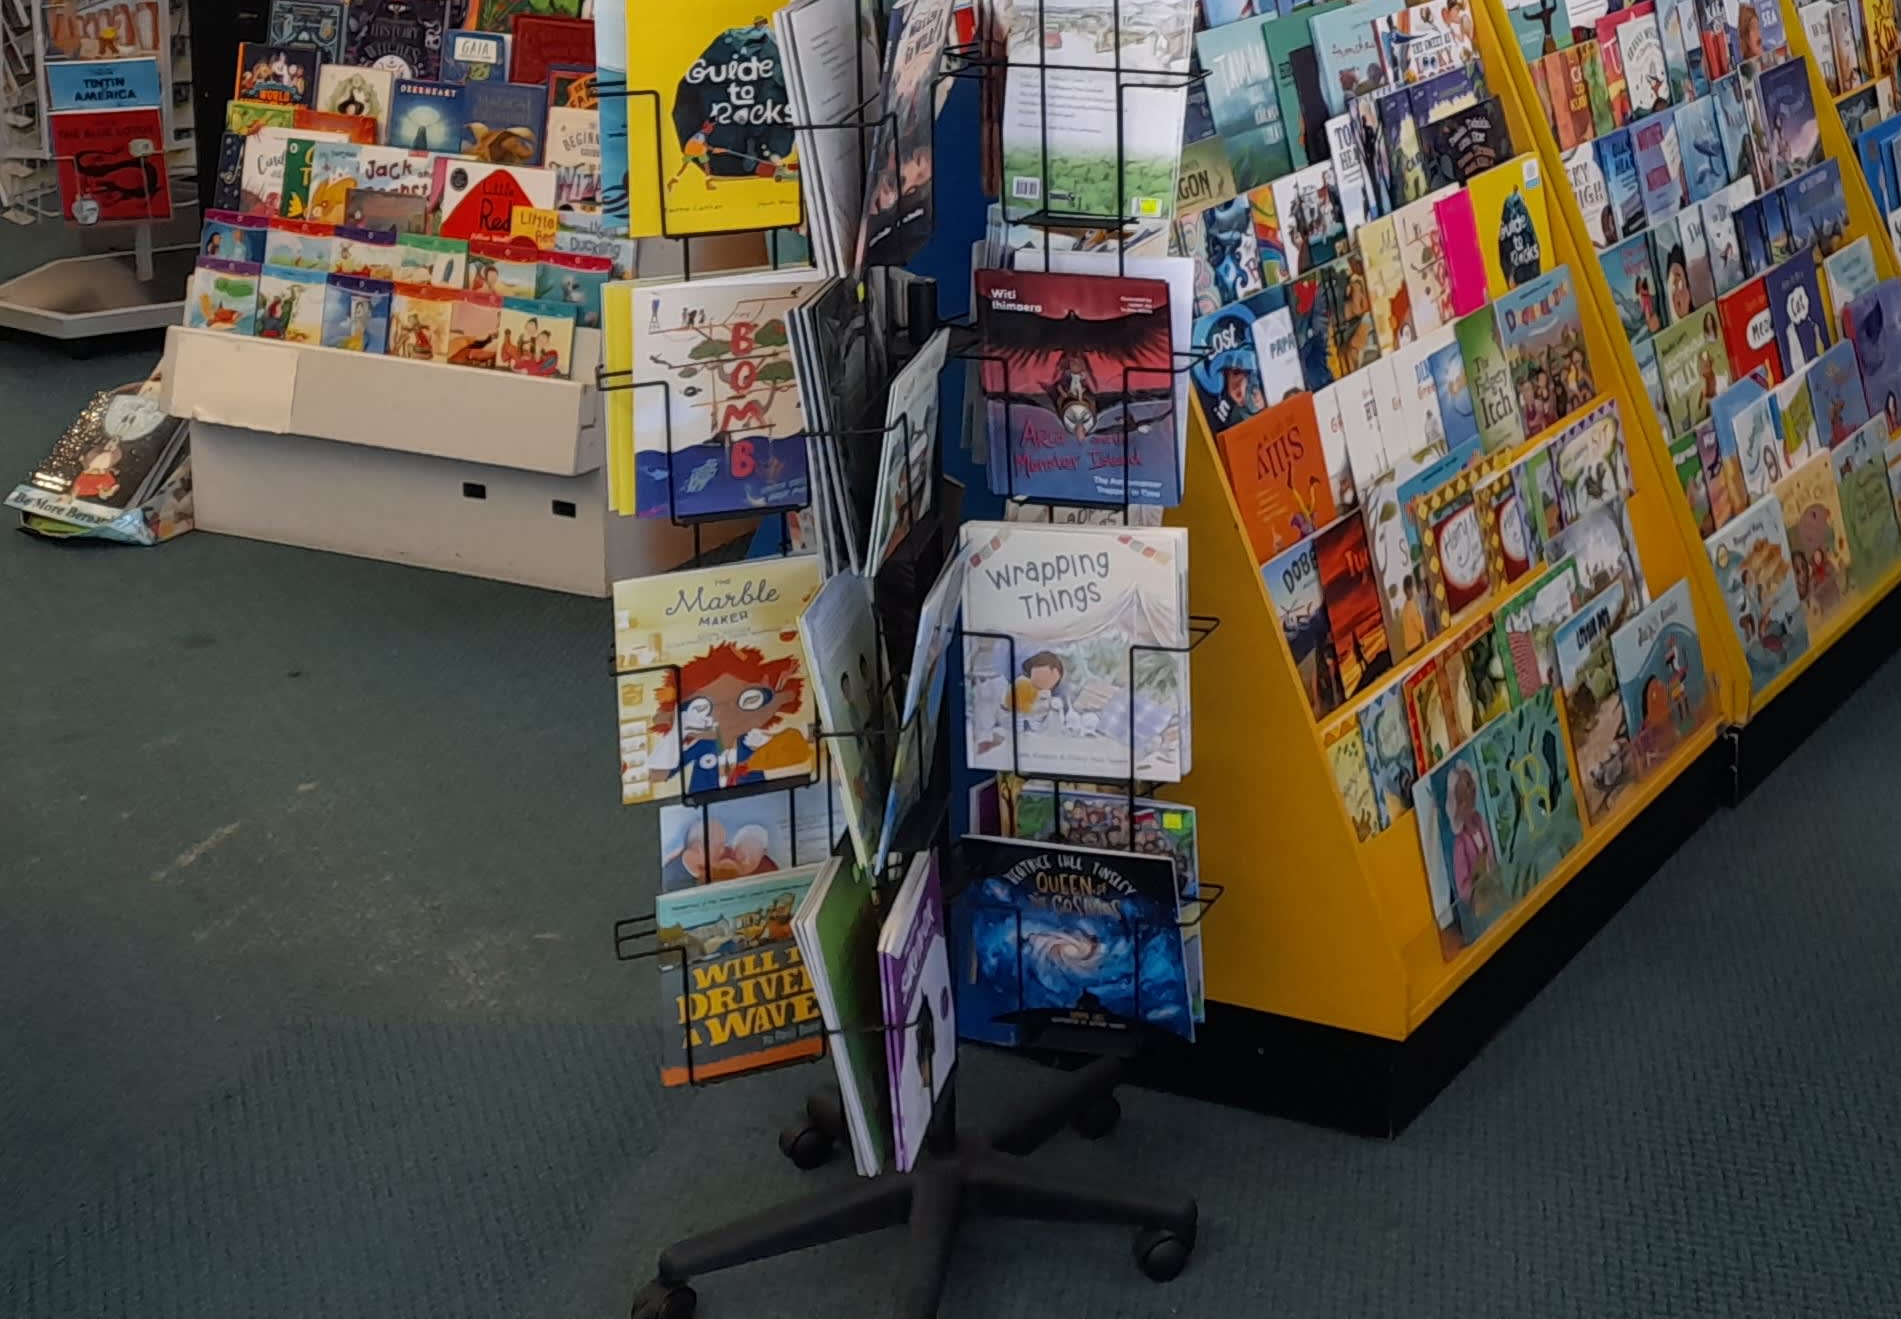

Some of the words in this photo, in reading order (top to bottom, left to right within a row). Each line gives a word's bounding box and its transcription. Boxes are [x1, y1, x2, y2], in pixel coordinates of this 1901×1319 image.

[1759, 11, 1778, 28] SEA
[461, 40, 491, 56] GAIA
[684, 56, 775, 85] Guide
[726, 81, 755, 106] to
[708, 102, 794, 127] Rocks
[364, 159, 414, 180] Jack
[991, 288, 1017, 299] Witi
[1214, 401, 1232, 423] in
[1481, 393, 1514, 431] Itch
[32, 498, 65, 514] More
[986, 550, 1111, 592] Wrapping
[663, 577, 782, 617] Marble
[1018, 583, 1102, 621] Things
[697, 610, 749, 628] MAKER
[1035, 871, 1092, 896] QUEEN
[692, 950, 780, 990] WILL
[705, 993, 821, 1047] WAVE
